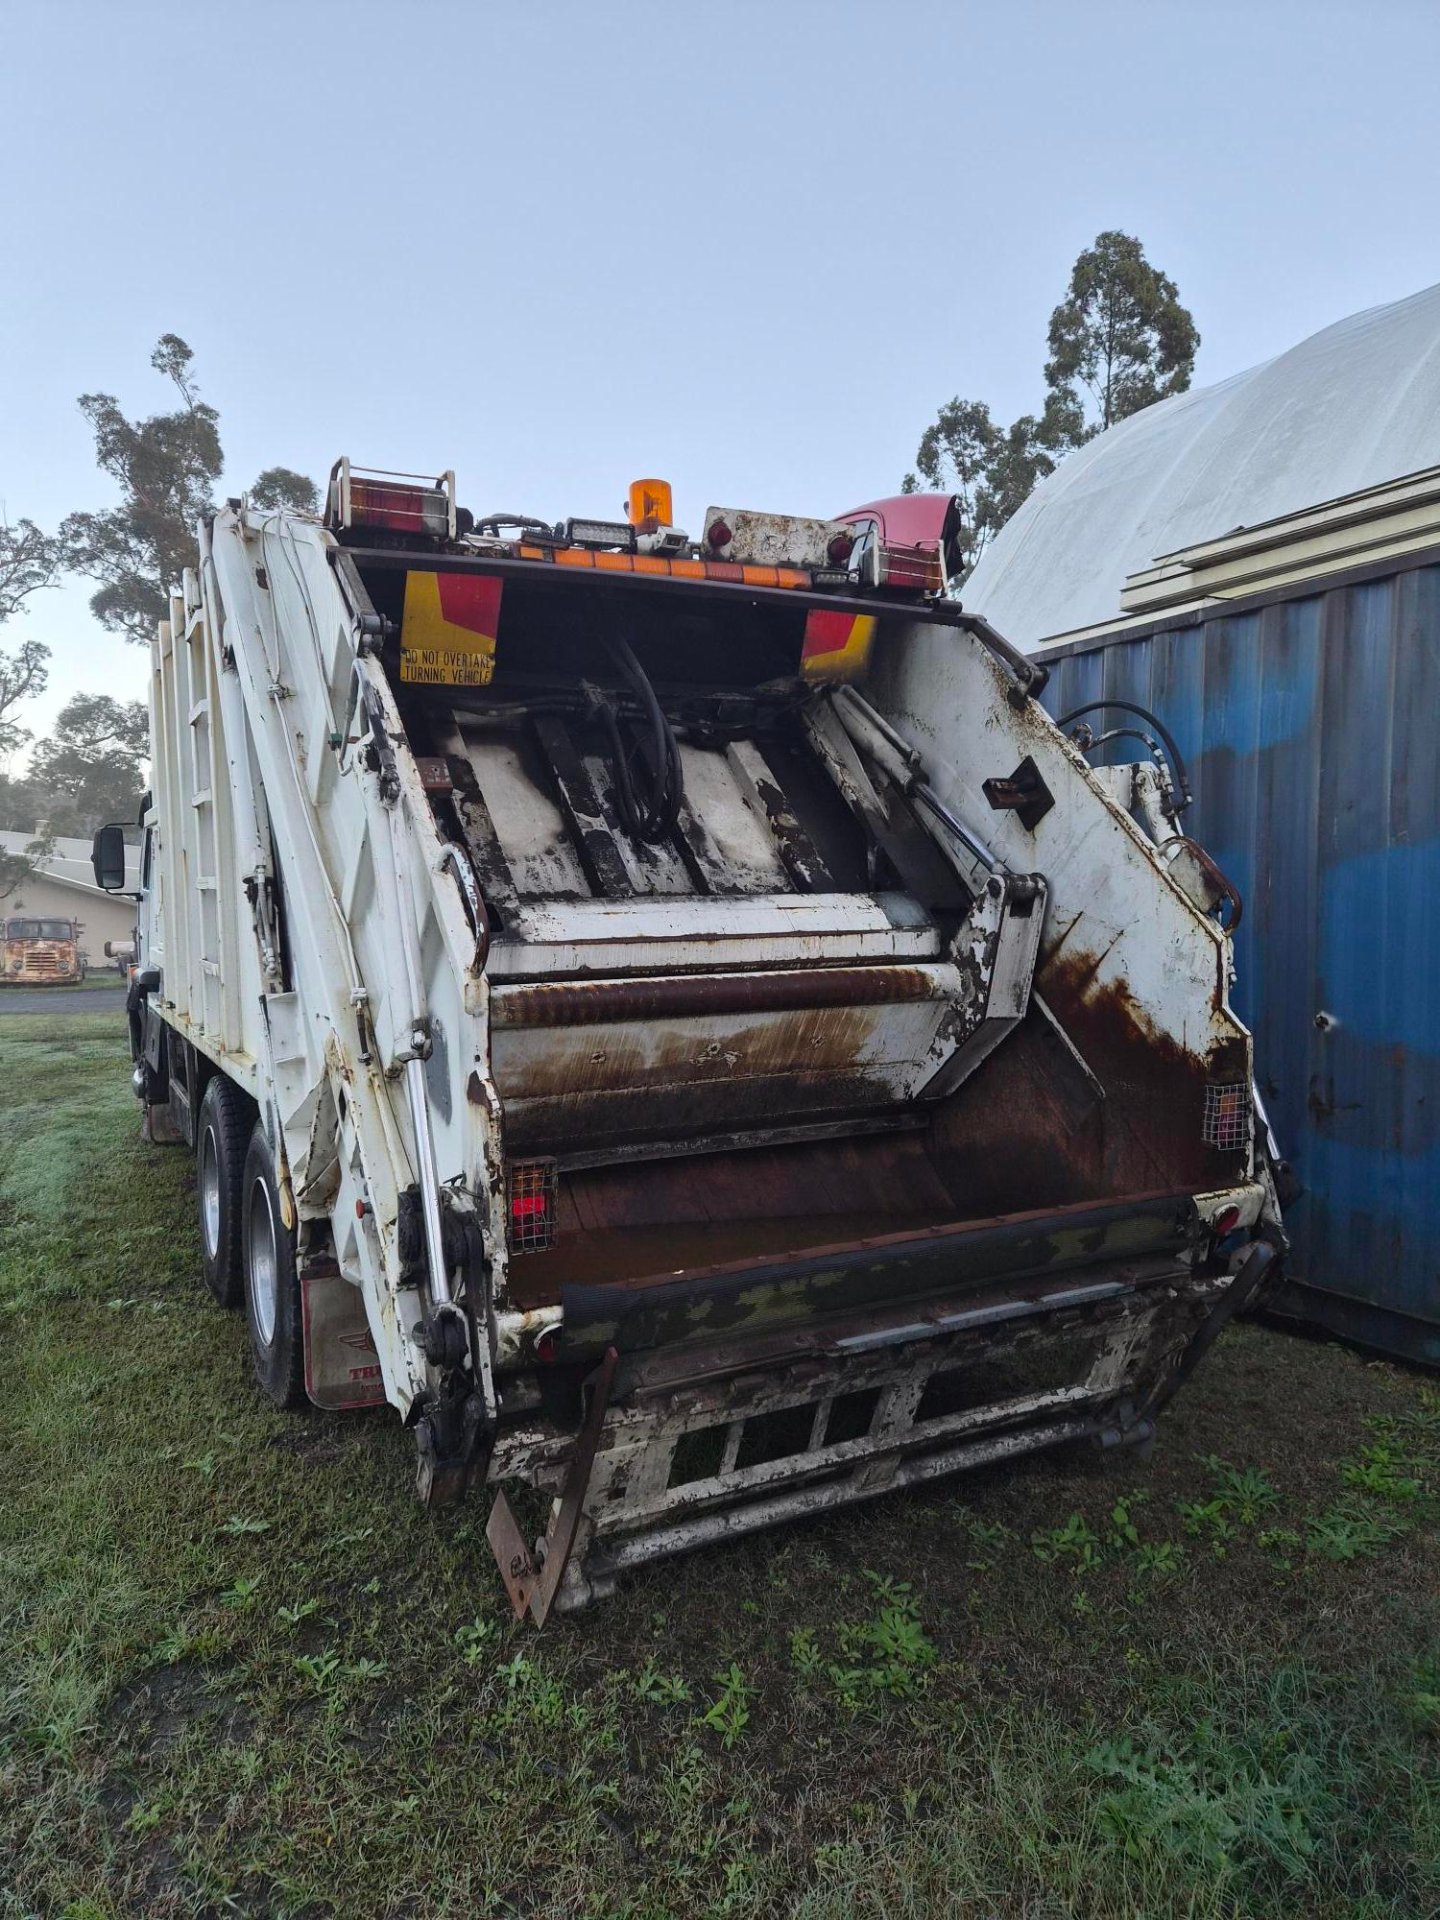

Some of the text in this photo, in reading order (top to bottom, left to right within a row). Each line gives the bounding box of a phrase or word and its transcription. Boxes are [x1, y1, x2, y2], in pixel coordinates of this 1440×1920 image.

[405, 649, 490, 669] DO NOT OVERTAKE
[405, 666, 490, 684] TURNING VEHICLE
